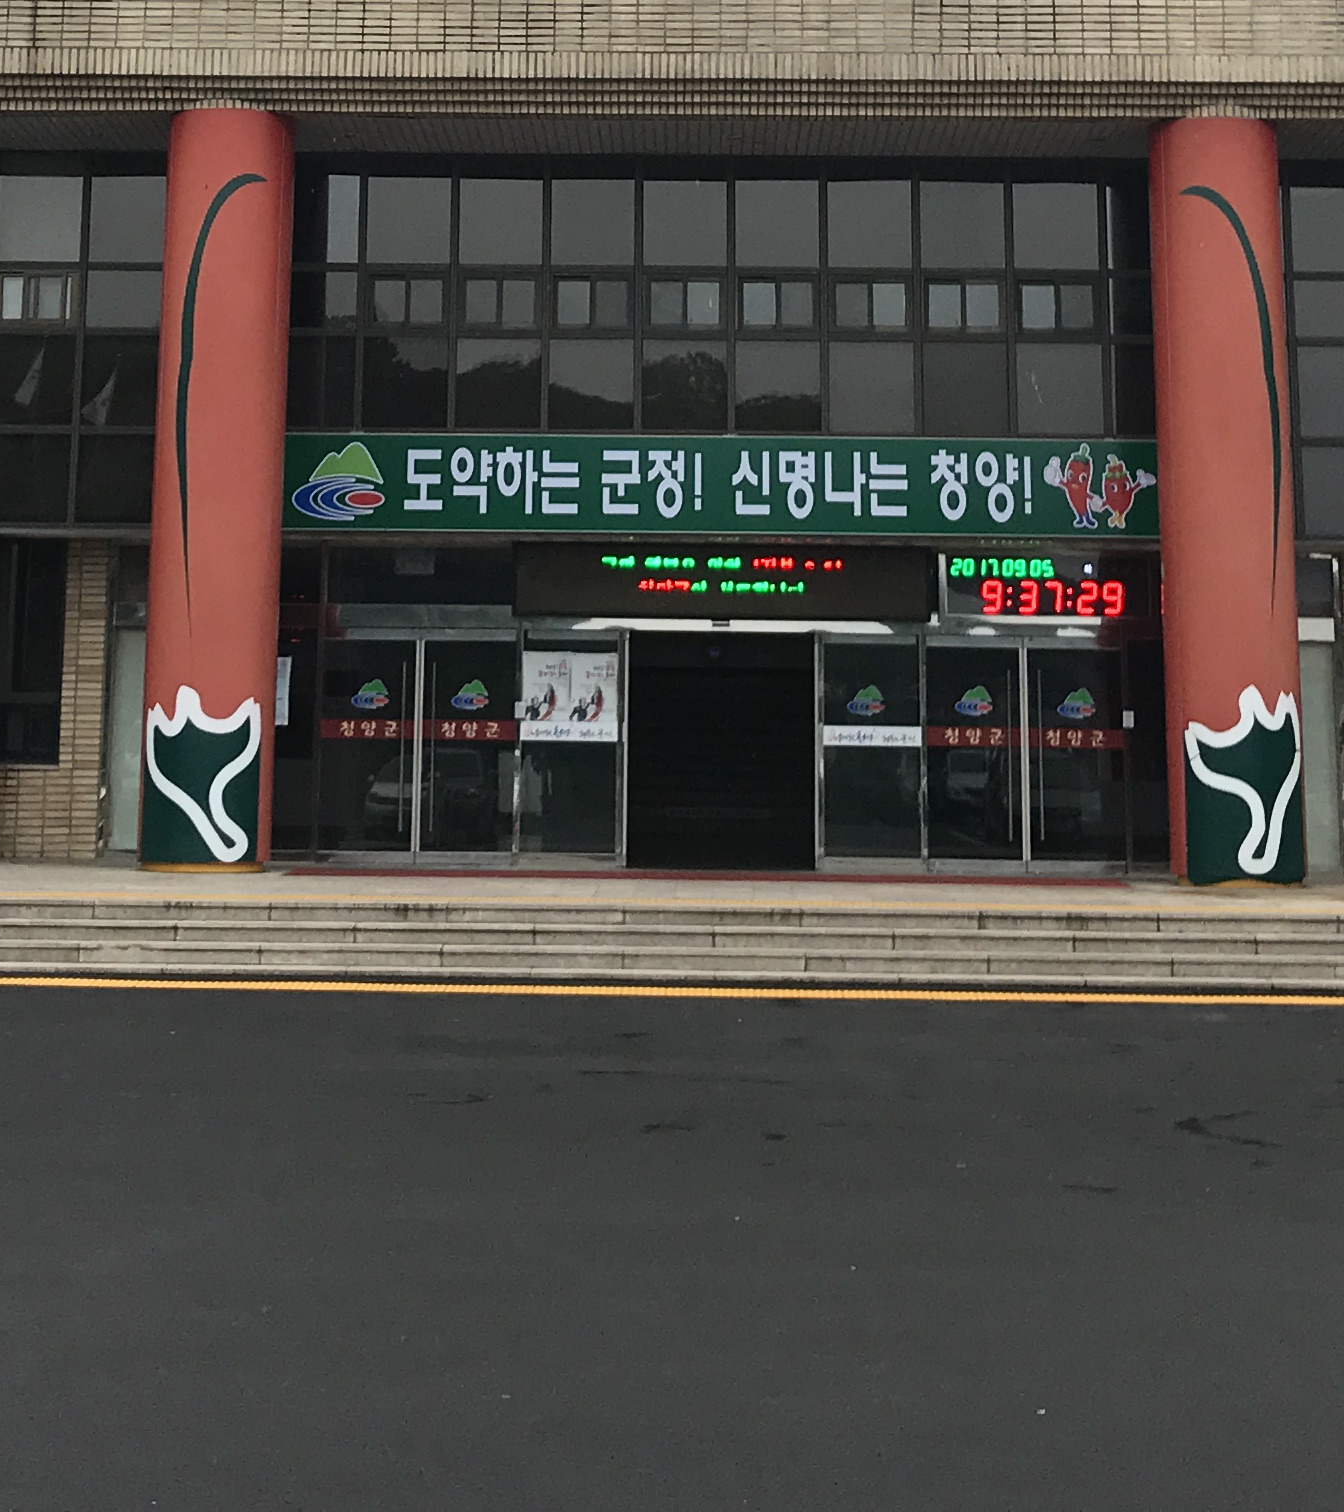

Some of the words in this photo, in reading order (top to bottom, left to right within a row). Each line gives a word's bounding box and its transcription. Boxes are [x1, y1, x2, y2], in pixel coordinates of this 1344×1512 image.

[403, 446, 581, 515] 도약하는
[600, 449, 703, 519] 군정!
[731, 449, 908, 520] 신명나는
[929, 448, 1033, 523] 청양!
[980, 578, 1126, 616] 9:37:29
